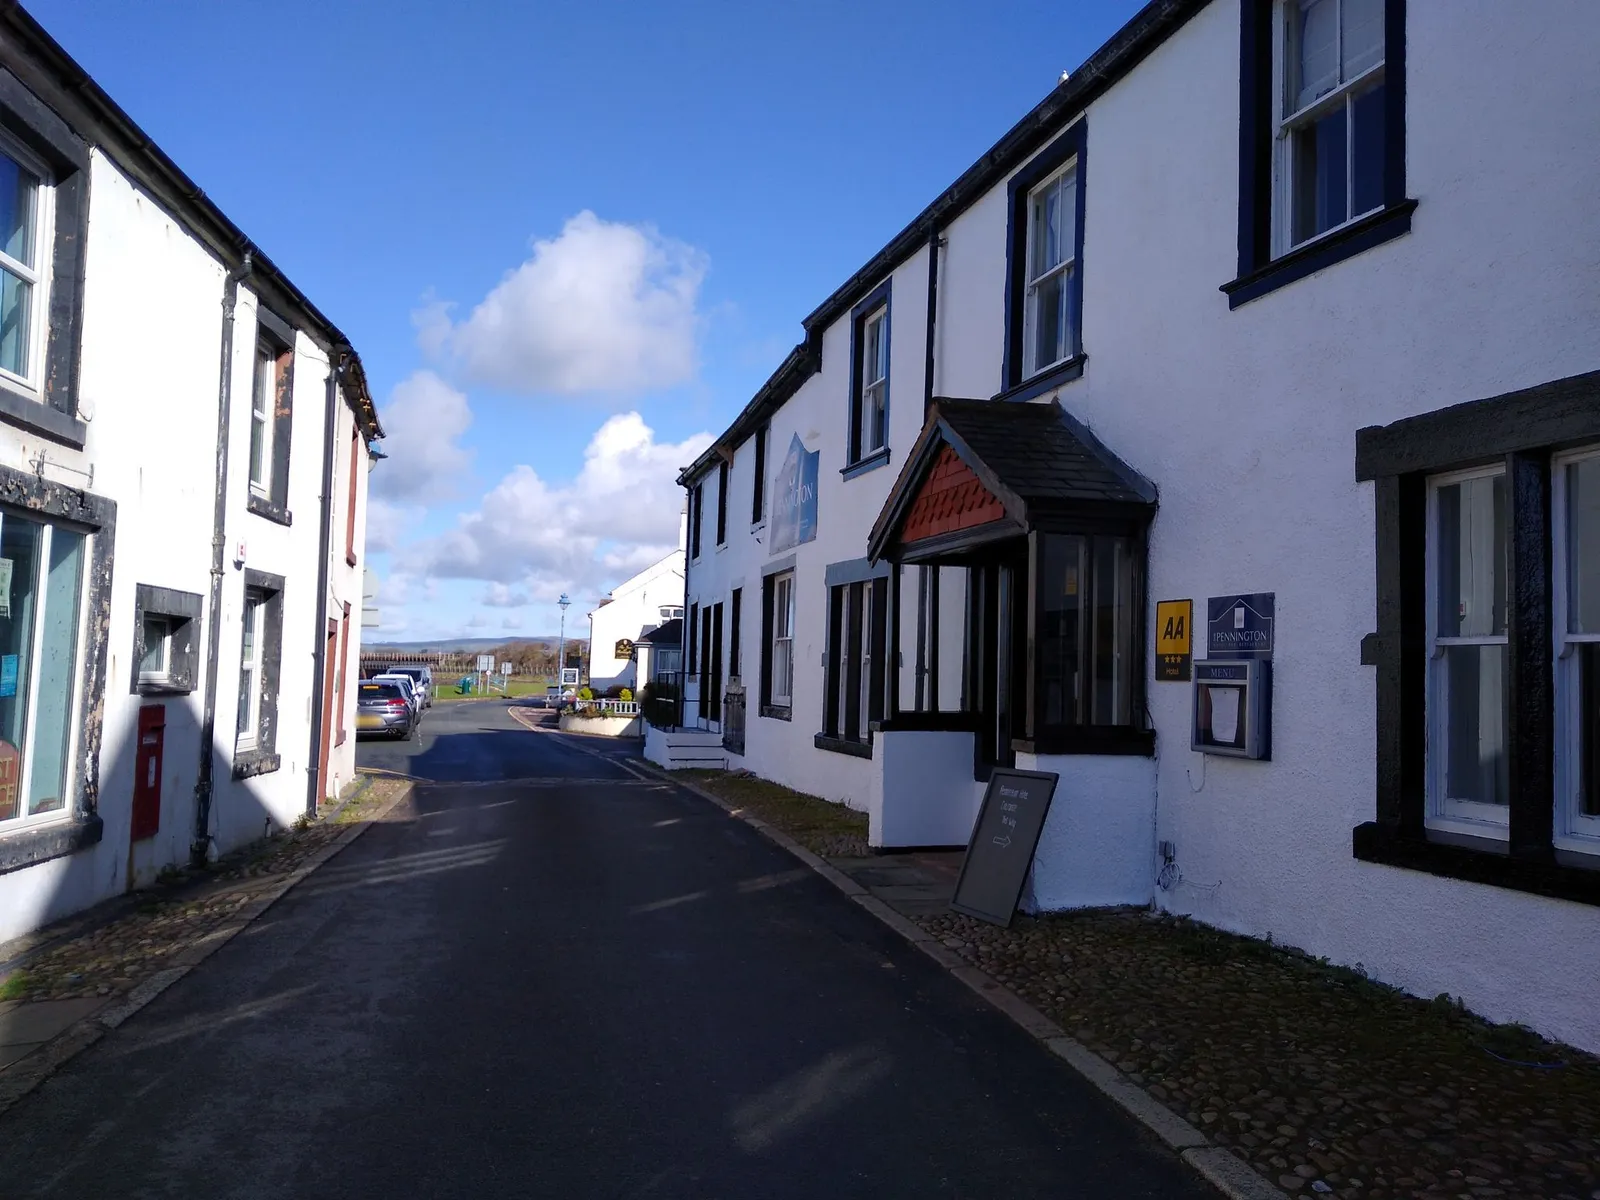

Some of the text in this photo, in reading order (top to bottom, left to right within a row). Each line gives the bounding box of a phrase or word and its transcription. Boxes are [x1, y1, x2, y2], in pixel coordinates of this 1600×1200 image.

[1163, 615, 1184, 640] AA
[1216, 630, 1267, 642] PENNINGTON
[1211, 668, 1234, 678] MENU
